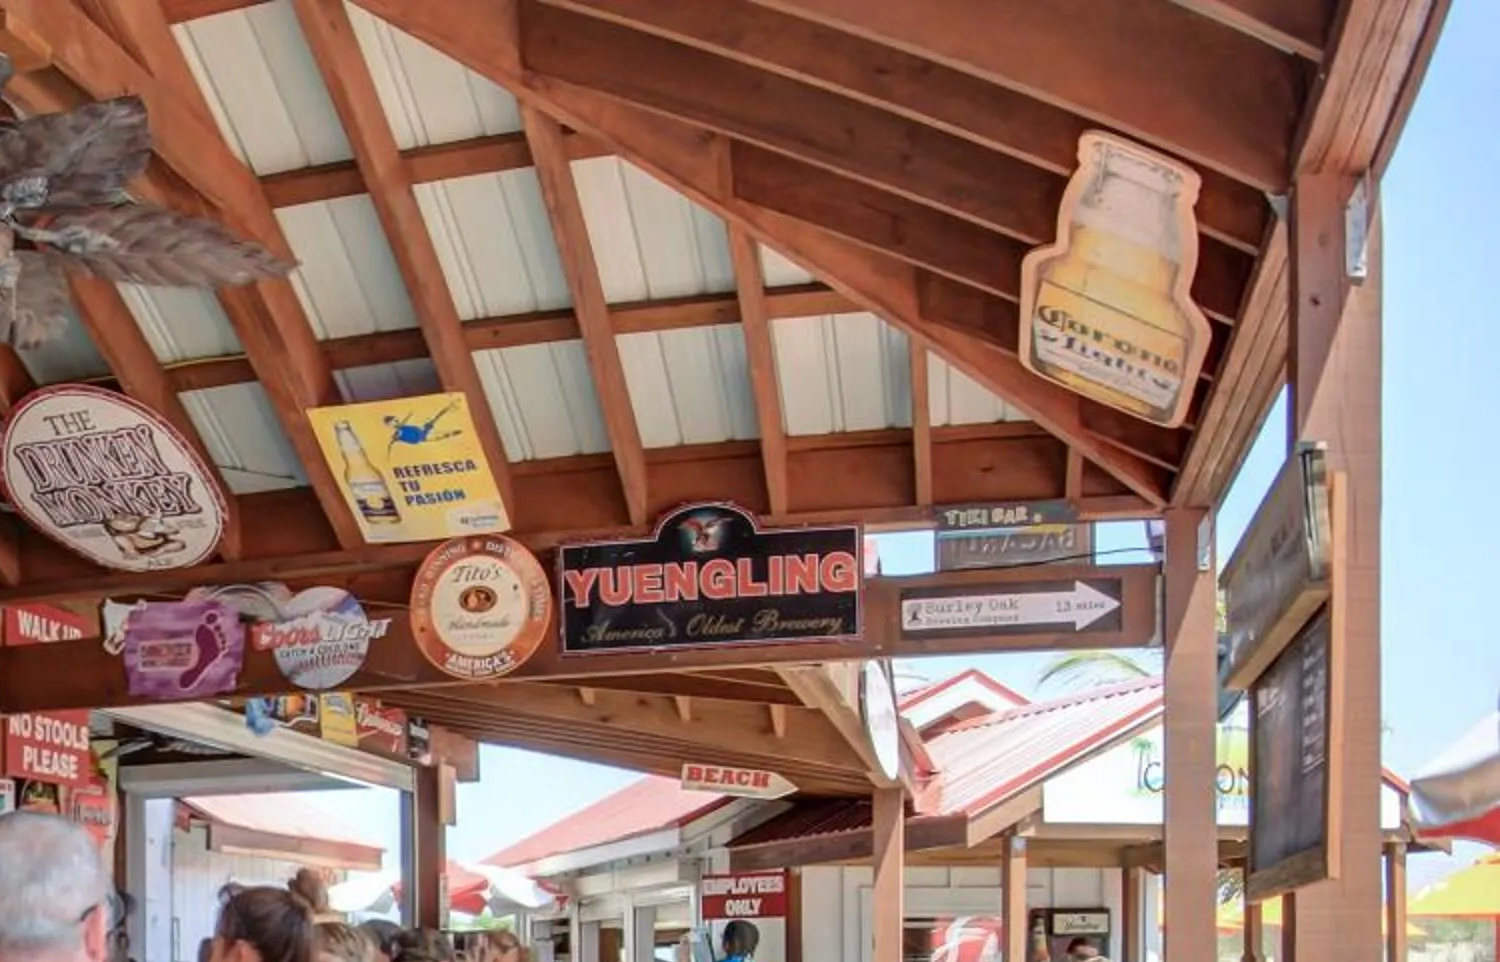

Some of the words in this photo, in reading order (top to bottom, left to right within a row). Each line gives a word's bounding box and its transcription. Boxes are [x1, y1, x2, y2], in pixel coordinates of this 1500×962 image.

[43, 409, 97, 437] THE
[392, 458, 478, 480] REFRESCA
[31, 472, 203, 528] MONKEY
[397, 479, 422, 495] TU
[942, 509, 989, 527] TIKI
[990, 506, 1028, 525] BAR
[451, 564, 504, 584] Tito's
[563, 550, 859, 609] YUENGLING
[924, 601, 984, 617] Burley
[988, 598, 1021, 612] Oak
[16, 608, 61, 642] WALK
[252, 619, 321, 652] Coors
[321, 618, 393, 642] LIGHT
[581, 607, 677, 644] America's
[686, 614, 744, 638] Oldest
[751, 608, 844, 636] Brewery
[9, 713, 33, 739] NO
[34, 715, 90, 751] STOOLS
[22, 745, 80, 779] PLEASE
[686, 765, 772, 790] BEACH
[702, 875, 785, 896] EMPLOYEES
[725, 898, 764, 918] ONLY
